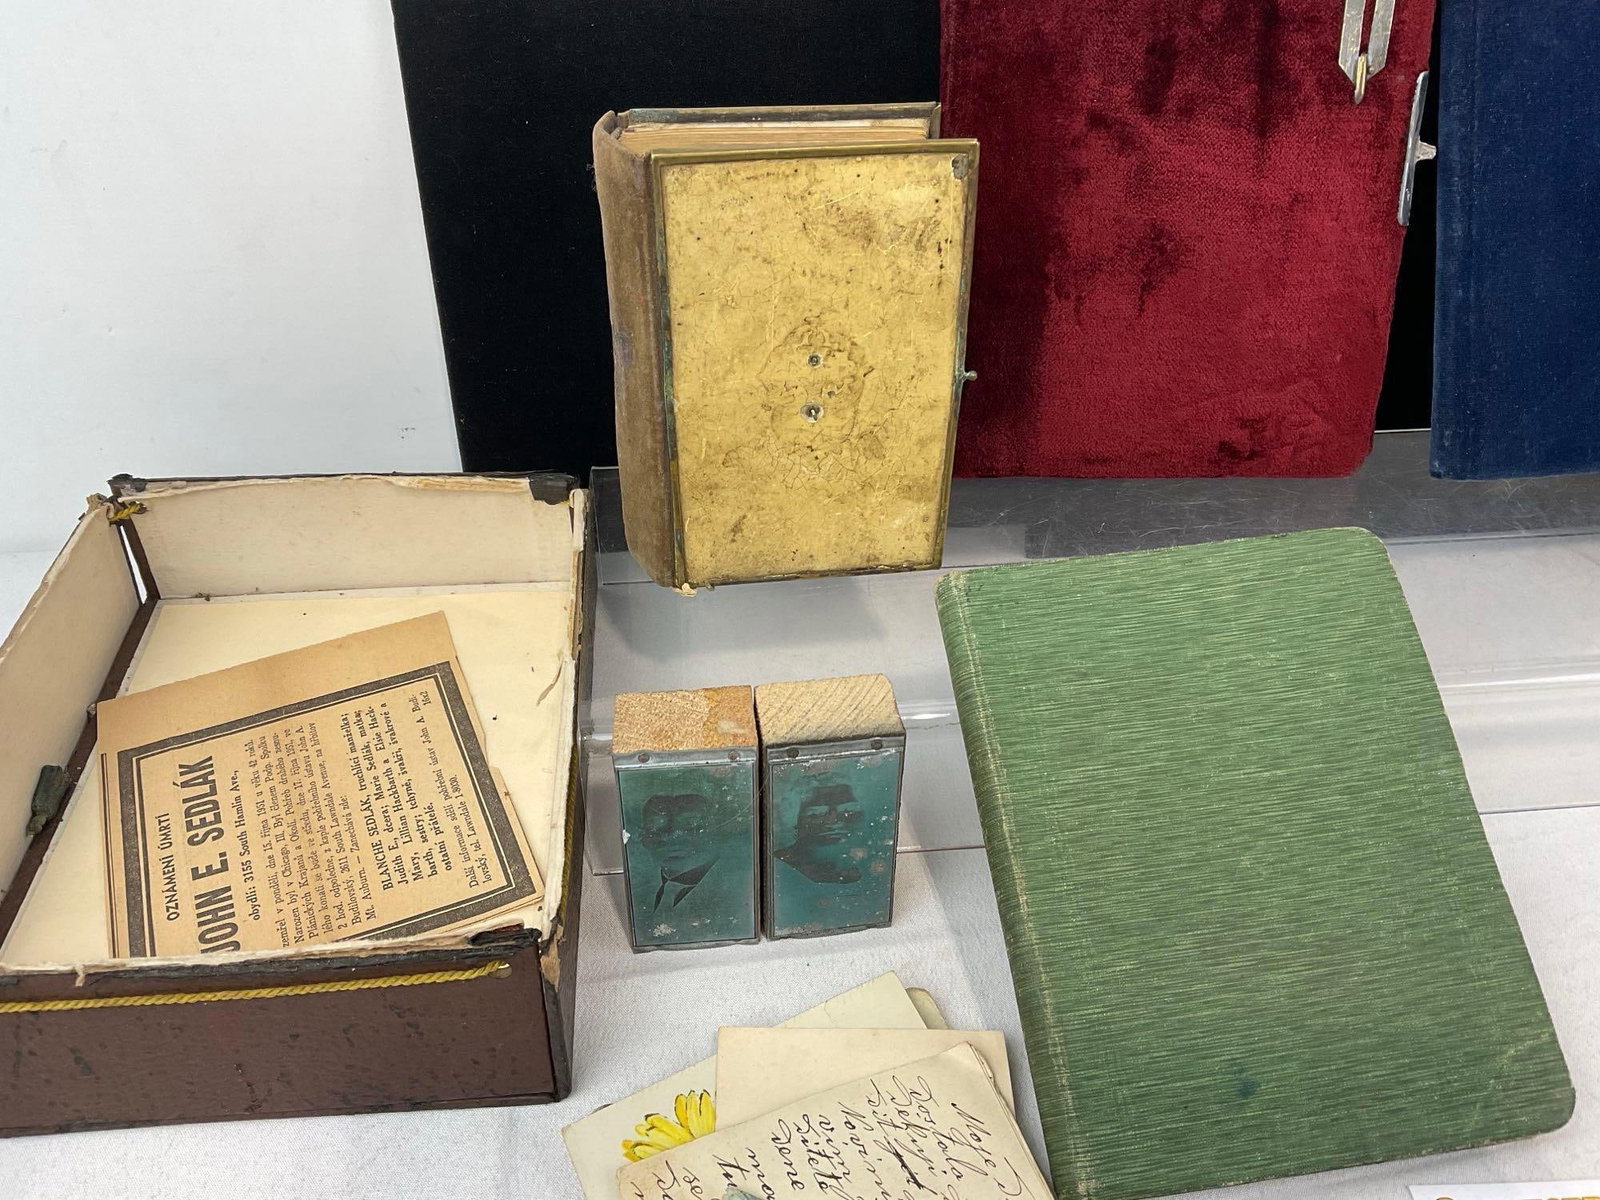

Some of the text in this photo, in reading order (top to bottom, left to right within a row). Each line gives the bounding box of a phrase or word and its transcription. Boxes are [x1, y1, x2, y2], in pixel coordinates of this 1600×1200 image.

[366, 706, 379, 729] Hack-
[380, 711, 398, 744] švakrové
[298, 736, 308, 752] John
[373, 732, 385, 751] Elsie
[421, 728, 431, 744] John
[315, 749, 323, 757] na
[361, 742, 376, 770] Sedlák,
[392, 748, 408, 774] švakři,
[427, 748, 438, 766] ústav
[251, 770, 261, 788] věku
[276, 758, 288, 784] drahého
[294, 779, 303, 789] 17.
[318, 760, 330, 788] Avenue,
[370, 776, 385, 800] Marie
[383, 767, 403, 812] Hackbarth
[433, 769, 452, 800] pohřební
[256, 800, 266, 816] 1951
[269, 786, 279, 810] členem
[284, 789, 294, 816] Pohřeb
[296, 792, 306, 805] dne
[324, 793, 340, 828] Lawndale
[339, 795, 350, 810] zde:
[341, 713, 394, 890] BLANCHE SEDLÁK, truchlící manželka;
[272, 814, 284, 828] Byl
[381, 805, 394, 832] dcera;
[444, 804, 457, 821] sdělí
[457, 801, 476, 837] Lawndale
[260, 820, 271, 838] října
[275, 831, 285, 842] Ill.
[316, 825, 329, 846] kaple
[342, 813, 360, 852] Zanechává
[399, 815, 412, 844] Lillian
[414, 814, 428, 843] sestry;
[424, 802, 452, 870] ostatní přátelé.
[173, 756, 240, 954] JOHN E. SEDLÁK
[230, 770, 260, 920] obydlí: 3155 South Hamlin Ave.,
[263, 840, 272, 851] 15.
[332, 831, 345, 854] South
[388, 838, 398, 850] E.,
[453, 825, 470, 862] informace
[470, 839, 481, 851] tel.
[155, 813, 180, 920] OZNÁMENÍ ÚMRTÍ
[266, 854, 276, 868] dne
[280, 844, 292, 877] Chicago,
[294, 855, 308, 888] Krajanů
[308, 850, 320, 870] bude
[338, 856, 350, 873] 2611
[392, 855, 408, 884] Judith
[411, 852, 423, 881] Mary,
[423, 848, 438, 877] barth,
[475, 854, 492, 883] lovský,
[326, 856, 340, 897] odpoledne,
[359, 867, 372, 900] Auburn.
[464, 866, 478, 888] Další
[286, 890, 298, 905] byl
[315, 885, 328, 912] konati
[342, 876, 362, 924] Budilovský,
[302, 892, 318, 938] Plánických
[334, 902, 346, 920] hod.
[365, 905, 376, 920] Mt.
[275, 918, 289, 947] zemřel
[292, 907, 304, 943] Narozen
[322, 915, 333, 934] lého
